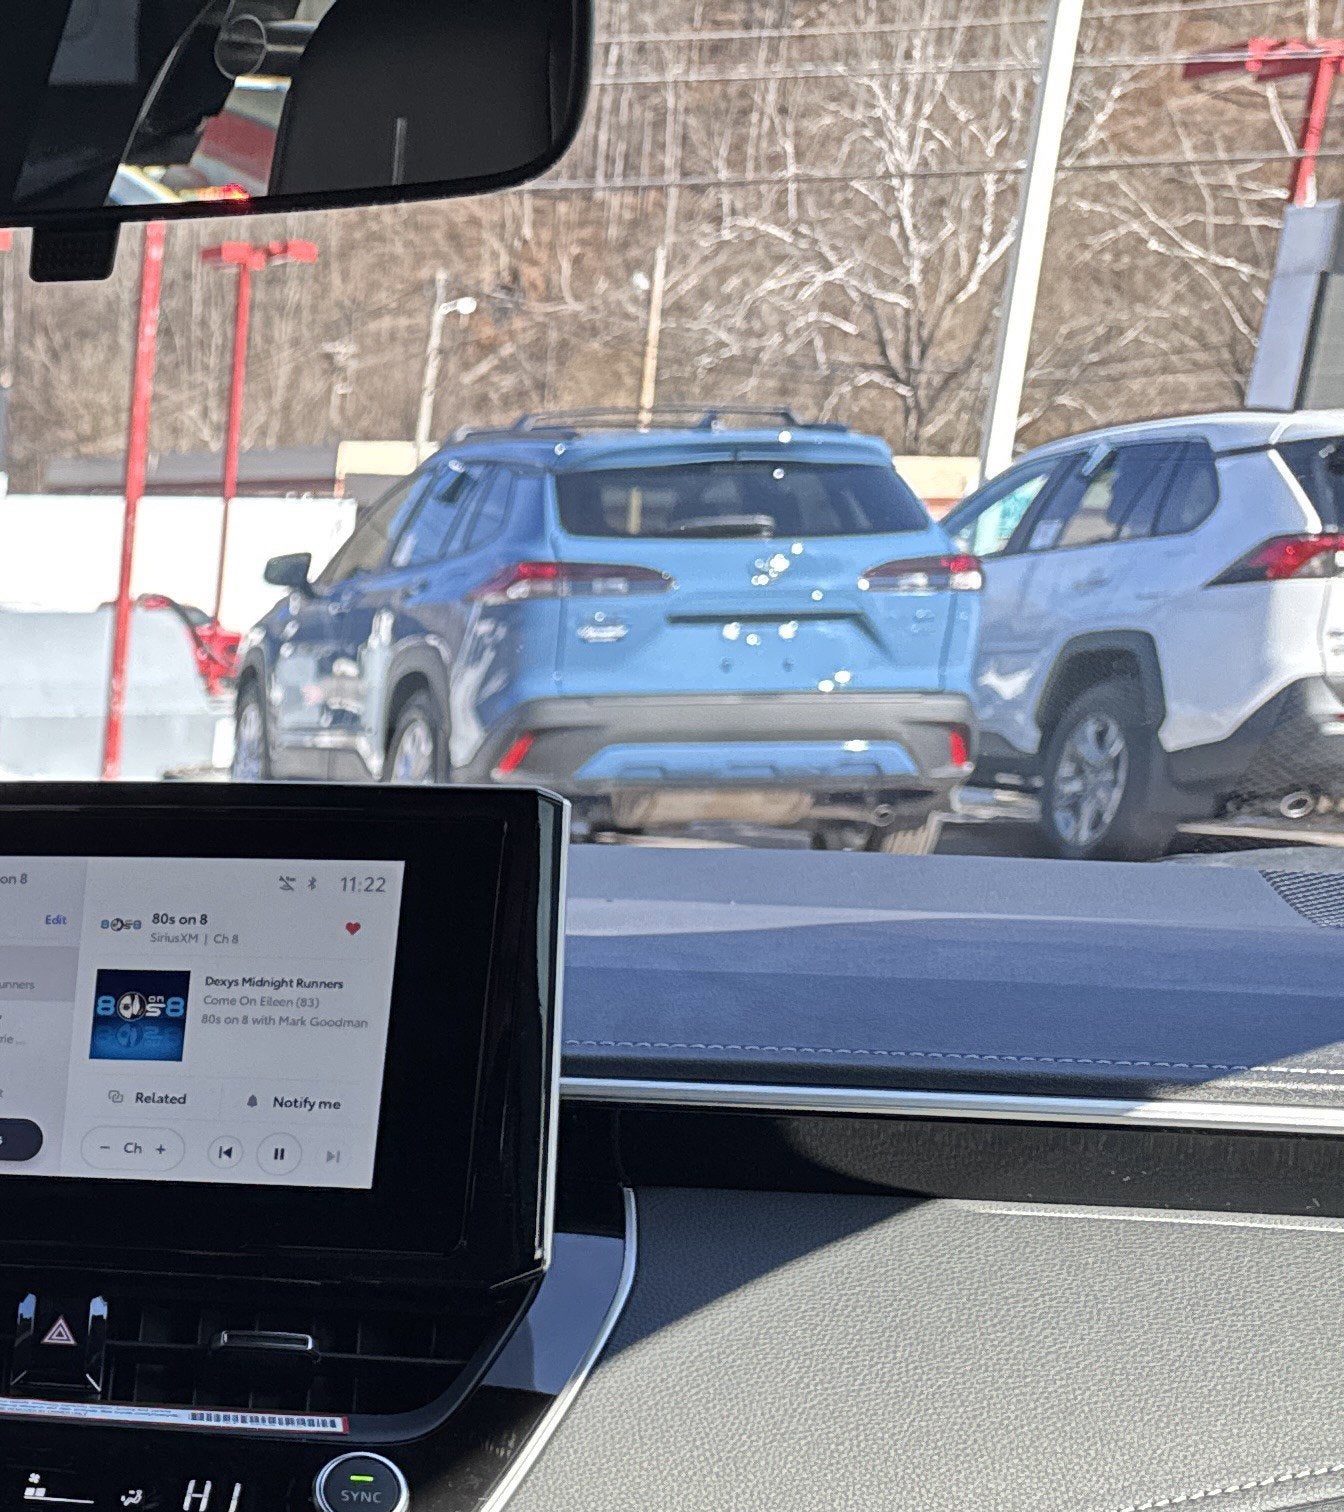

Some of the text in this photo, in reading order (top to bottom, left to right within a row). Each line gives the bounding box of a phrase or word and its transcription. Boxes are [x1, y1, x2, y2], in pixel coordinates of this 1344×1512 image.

[0, 874, 17, 885] on
[19, 872, 28, 885] 8
[340, 876, 387, 893] 11:22
[45, 914, 67, 925] Edit
[152, 913, 208, 926] 80s on 8
[150, 932, 239, 945] SiriusXM Ch 8
[205, 976, 344, 989] Dexys Midnight Runners
[203, 995, 237, 1006] Come
[239, 996, 257, 1006] On
[260, 996, 294, 1007] Eileen
[201, 1014, 369, 1029] 80s on 8 with Mark Goodman
[134, 1092, 187, 1105] Related
[273, 1096, 341, 1111] Notify me
[123, 1141, 142, 1154] Ch
[340, 1490, 382, 1504] SYNC
